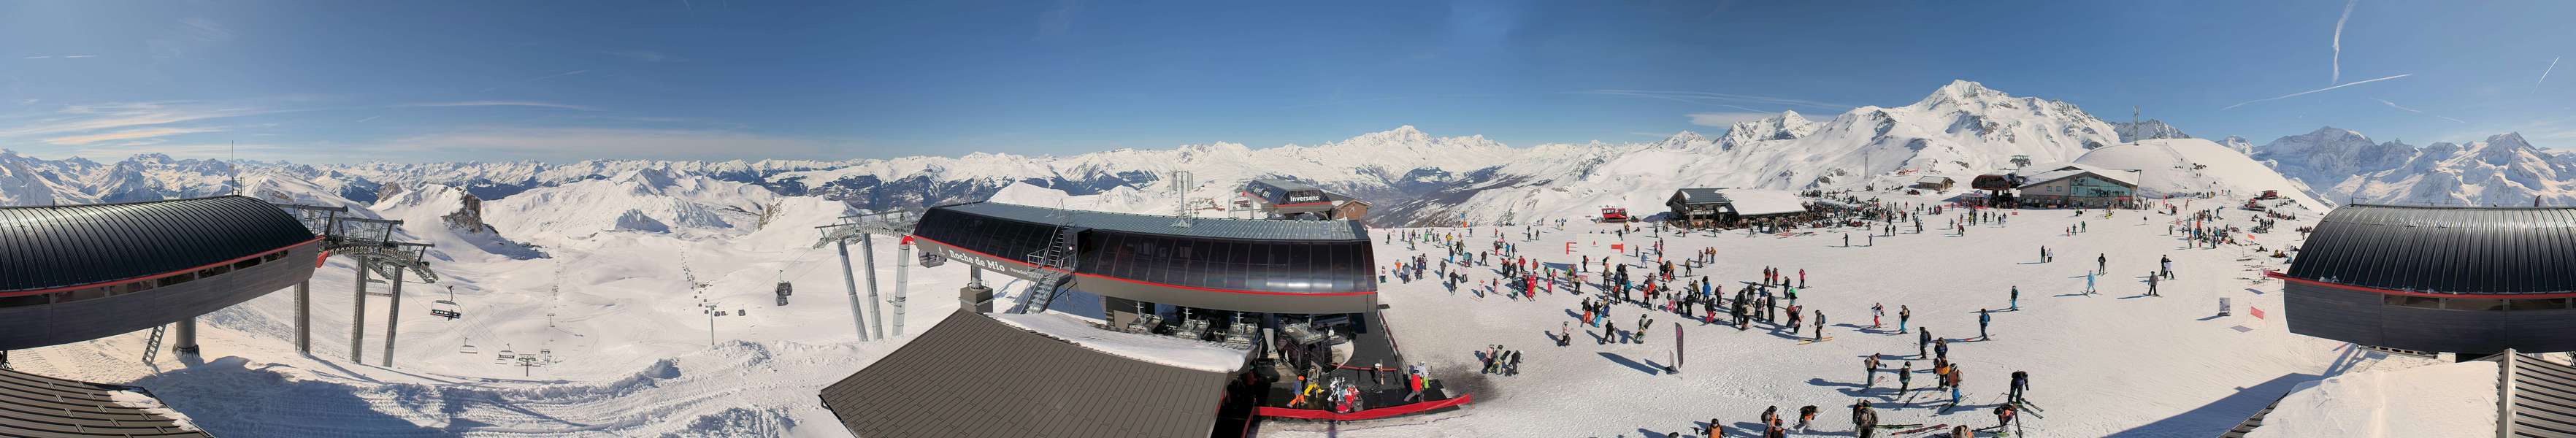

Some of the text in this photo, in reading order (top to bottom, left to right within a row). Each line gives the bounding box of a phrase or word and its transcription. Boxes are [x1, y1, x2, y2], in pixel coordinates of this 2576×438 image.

[948, 250, 1005, 272] Roche de Mio
